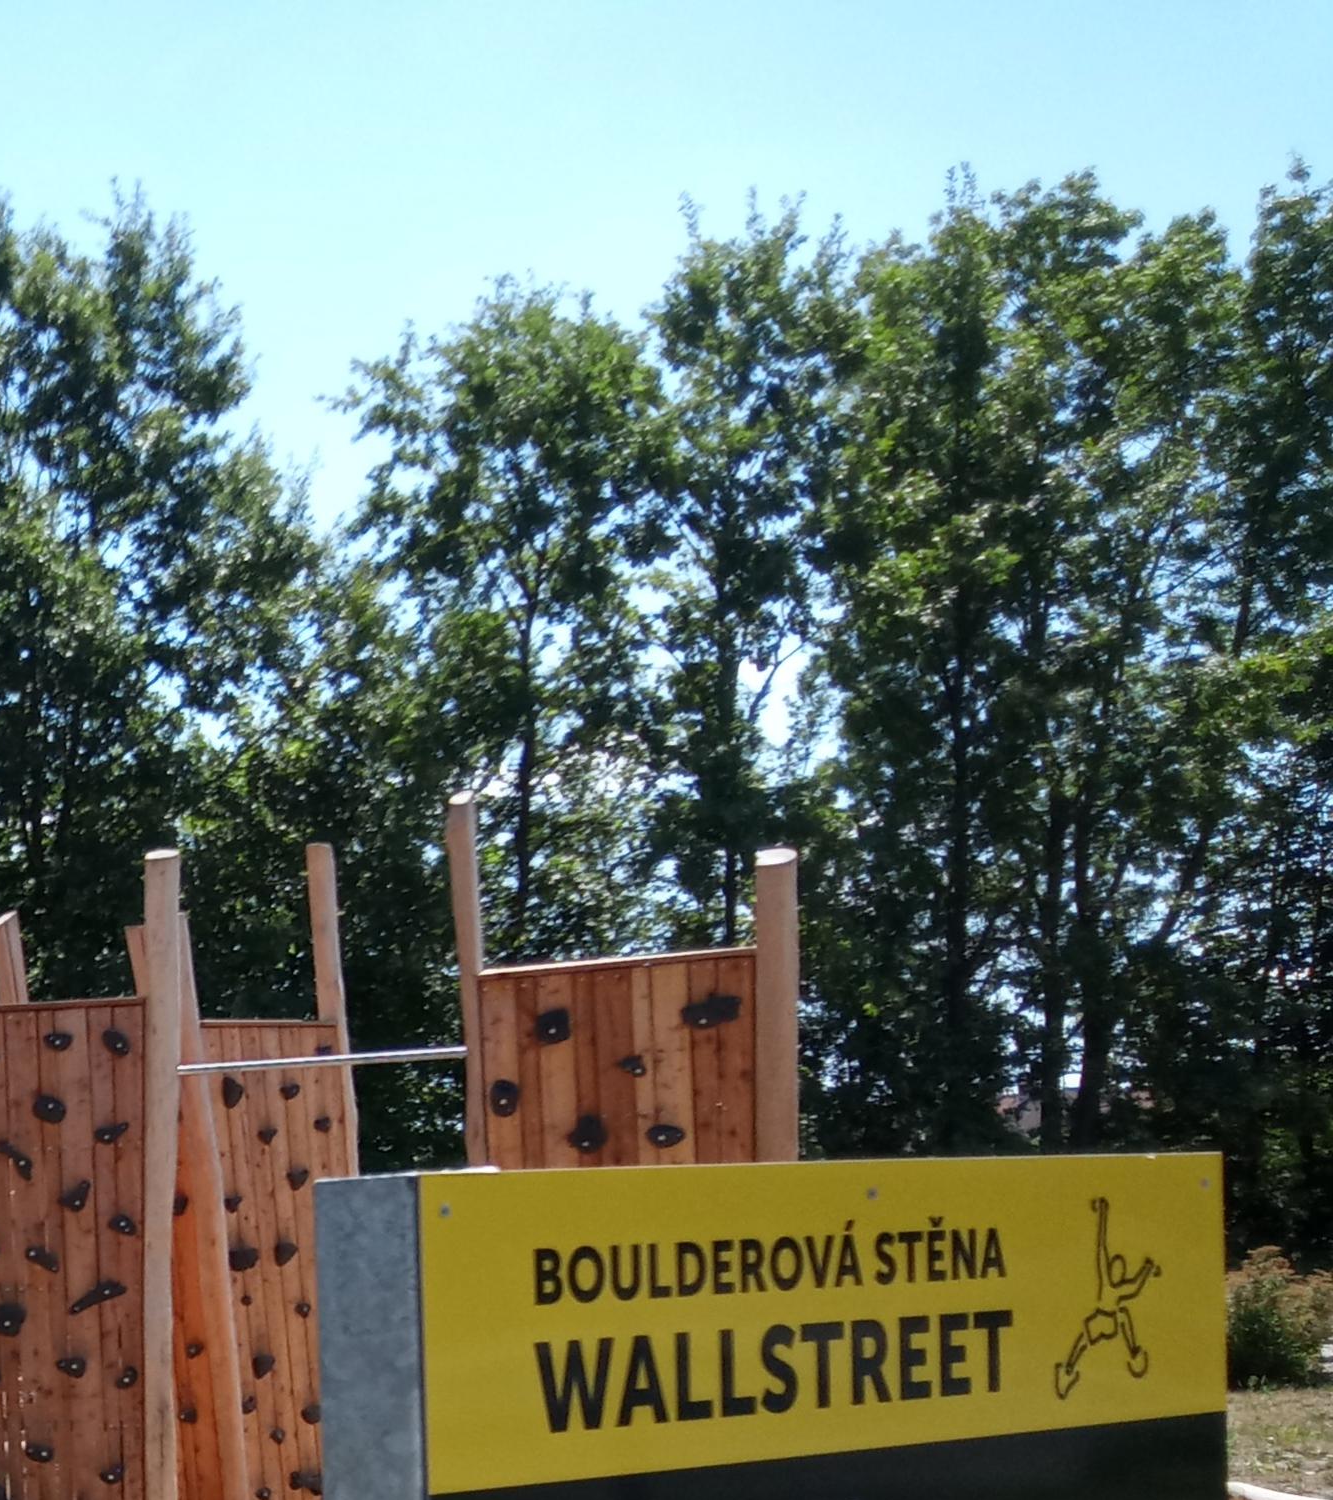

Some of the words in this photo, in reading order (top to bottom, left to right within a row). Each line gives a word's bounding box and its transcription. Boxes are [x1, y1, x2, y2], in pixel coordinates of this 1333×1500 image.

[534, 1219, 861, 1306] BOULDEROVÁ
[873, 1215, 1007, 1288] STĚNA
[534, 1309, 1014, 1435] WALLSTREET
